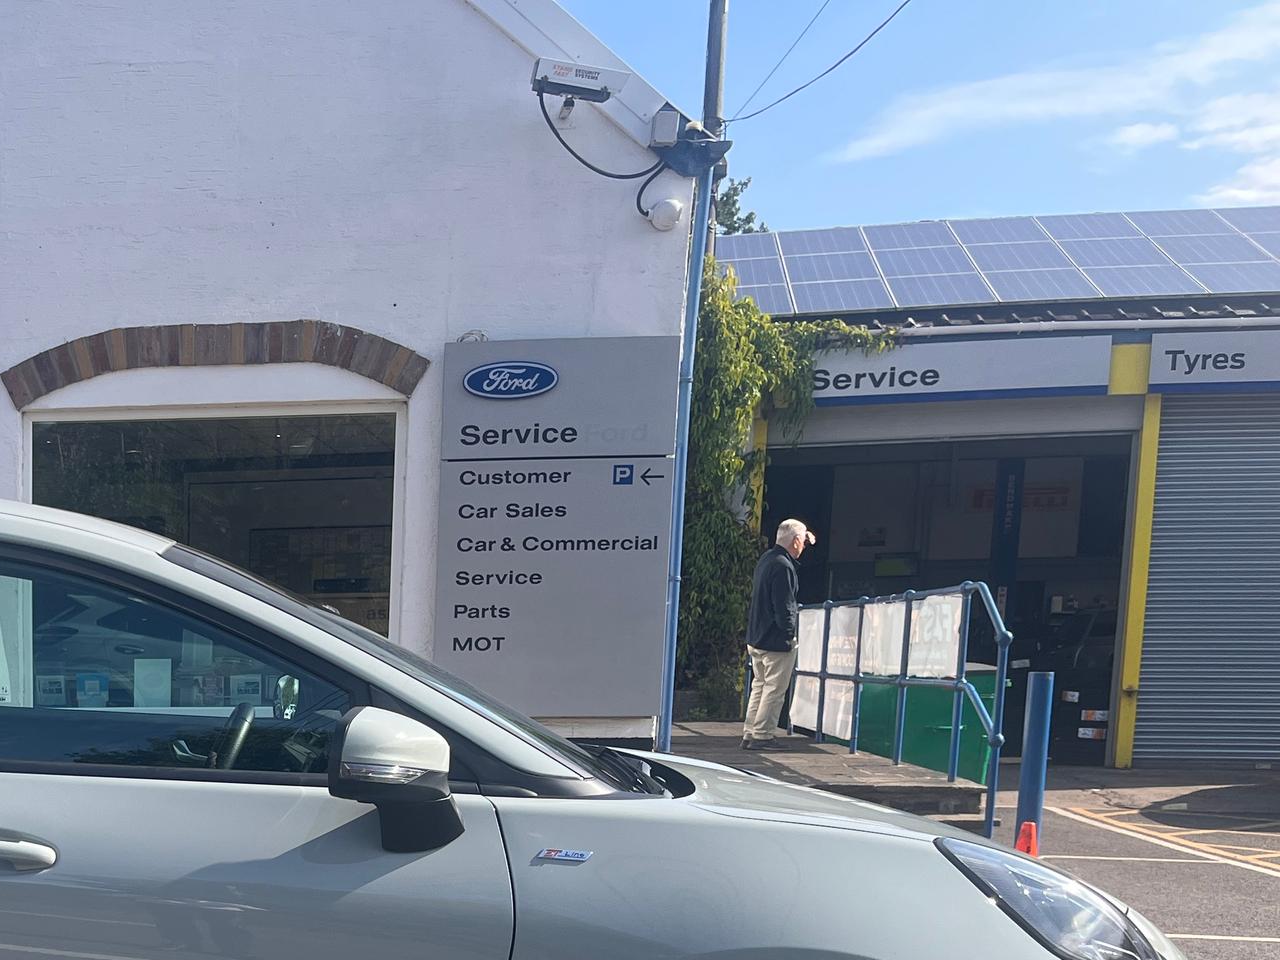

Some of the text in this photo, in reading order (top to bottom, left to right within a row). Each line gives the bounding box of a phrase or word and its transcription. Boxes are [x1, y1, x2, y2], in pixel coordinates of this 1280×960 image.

[1164, 349, 1246, 375] Tyres
[814, 366, 940, 391] Service
[460, 423, 578, 446] Service
[459, 469, 572, 486] Customer
[458, 502, 567, 520] Car Sales
[456, 535, 658, 553] Car & Commercial
[455, 570, 543, 586] Service
[453, 603, 511, 619] Parts
[452, 636, 506, 652] MOT
